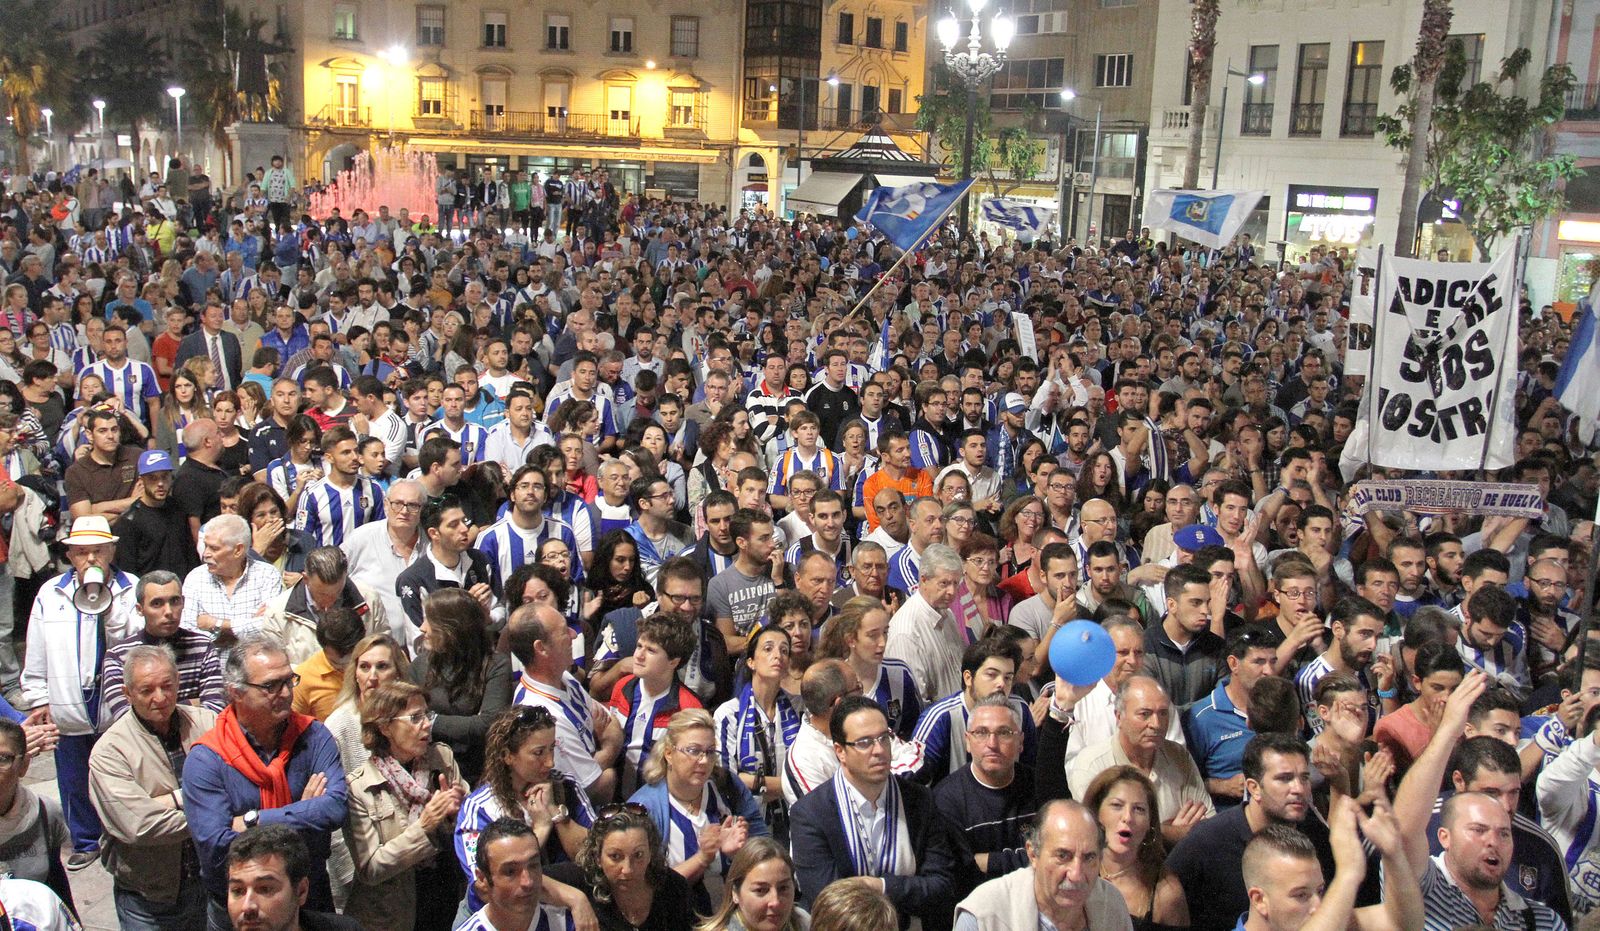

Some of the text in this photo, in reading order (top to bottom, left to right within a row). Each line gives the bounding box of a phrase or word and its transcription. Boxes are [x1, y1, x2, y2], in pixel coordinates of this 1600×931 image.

[1354, 488, 1373, 507] EAL
[1376, 488, 1402, 502] CLUB
[1405, 486, 1482, 508] RECREATIVO
[1483, 493, 1499, 507] DE
